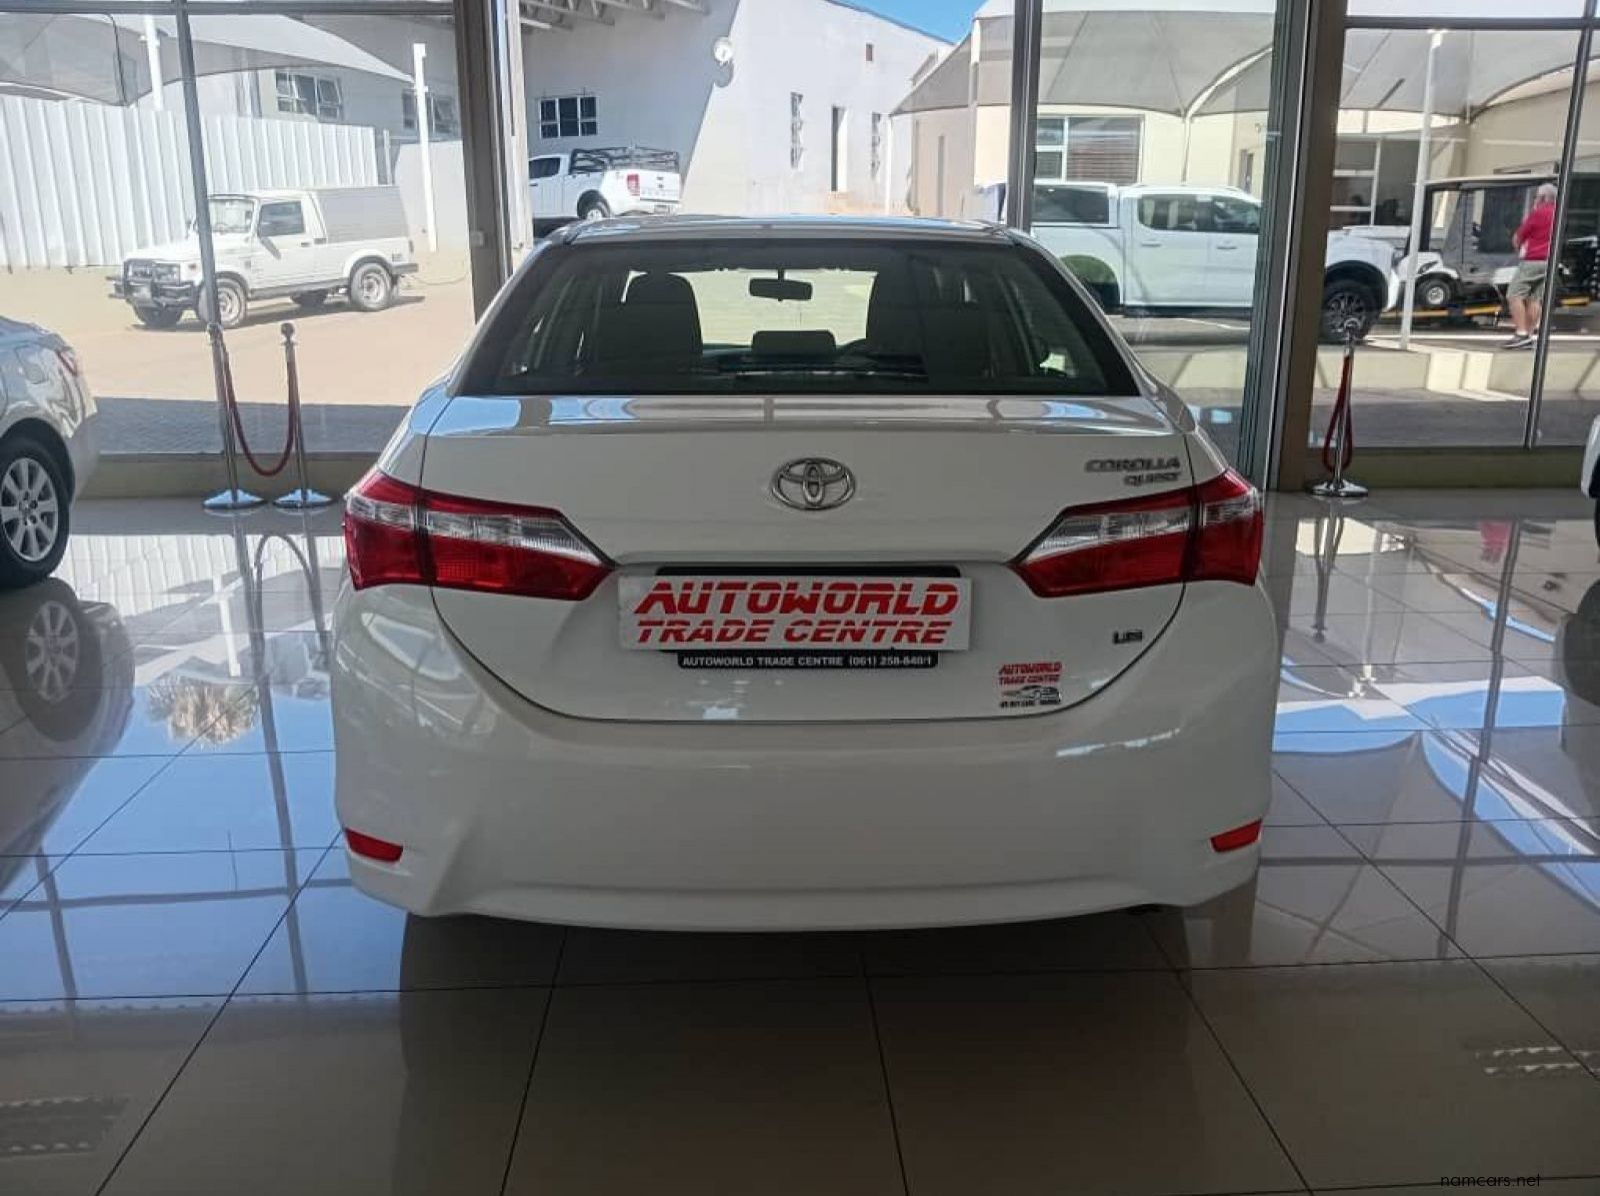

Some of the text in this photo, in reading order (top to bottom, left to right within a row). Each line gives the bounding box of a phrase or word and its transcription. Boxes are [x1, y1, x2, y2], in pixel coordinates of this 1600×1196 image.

[1084, 457, 1181, 473] COROLLA
[1123, 472, 1181, 486] QUEST
[634, 581, 959, 615] AUTOWORLD
[637, 619, 953, 644] TRADE CENTRE
[683, 655, 754, 667] AUTOWORLD
[757, 655, 795, 666] TRADE
[797, 655, 844, 666] CENTRE
[998, 661, 1062, 675] AUTOWORLD
